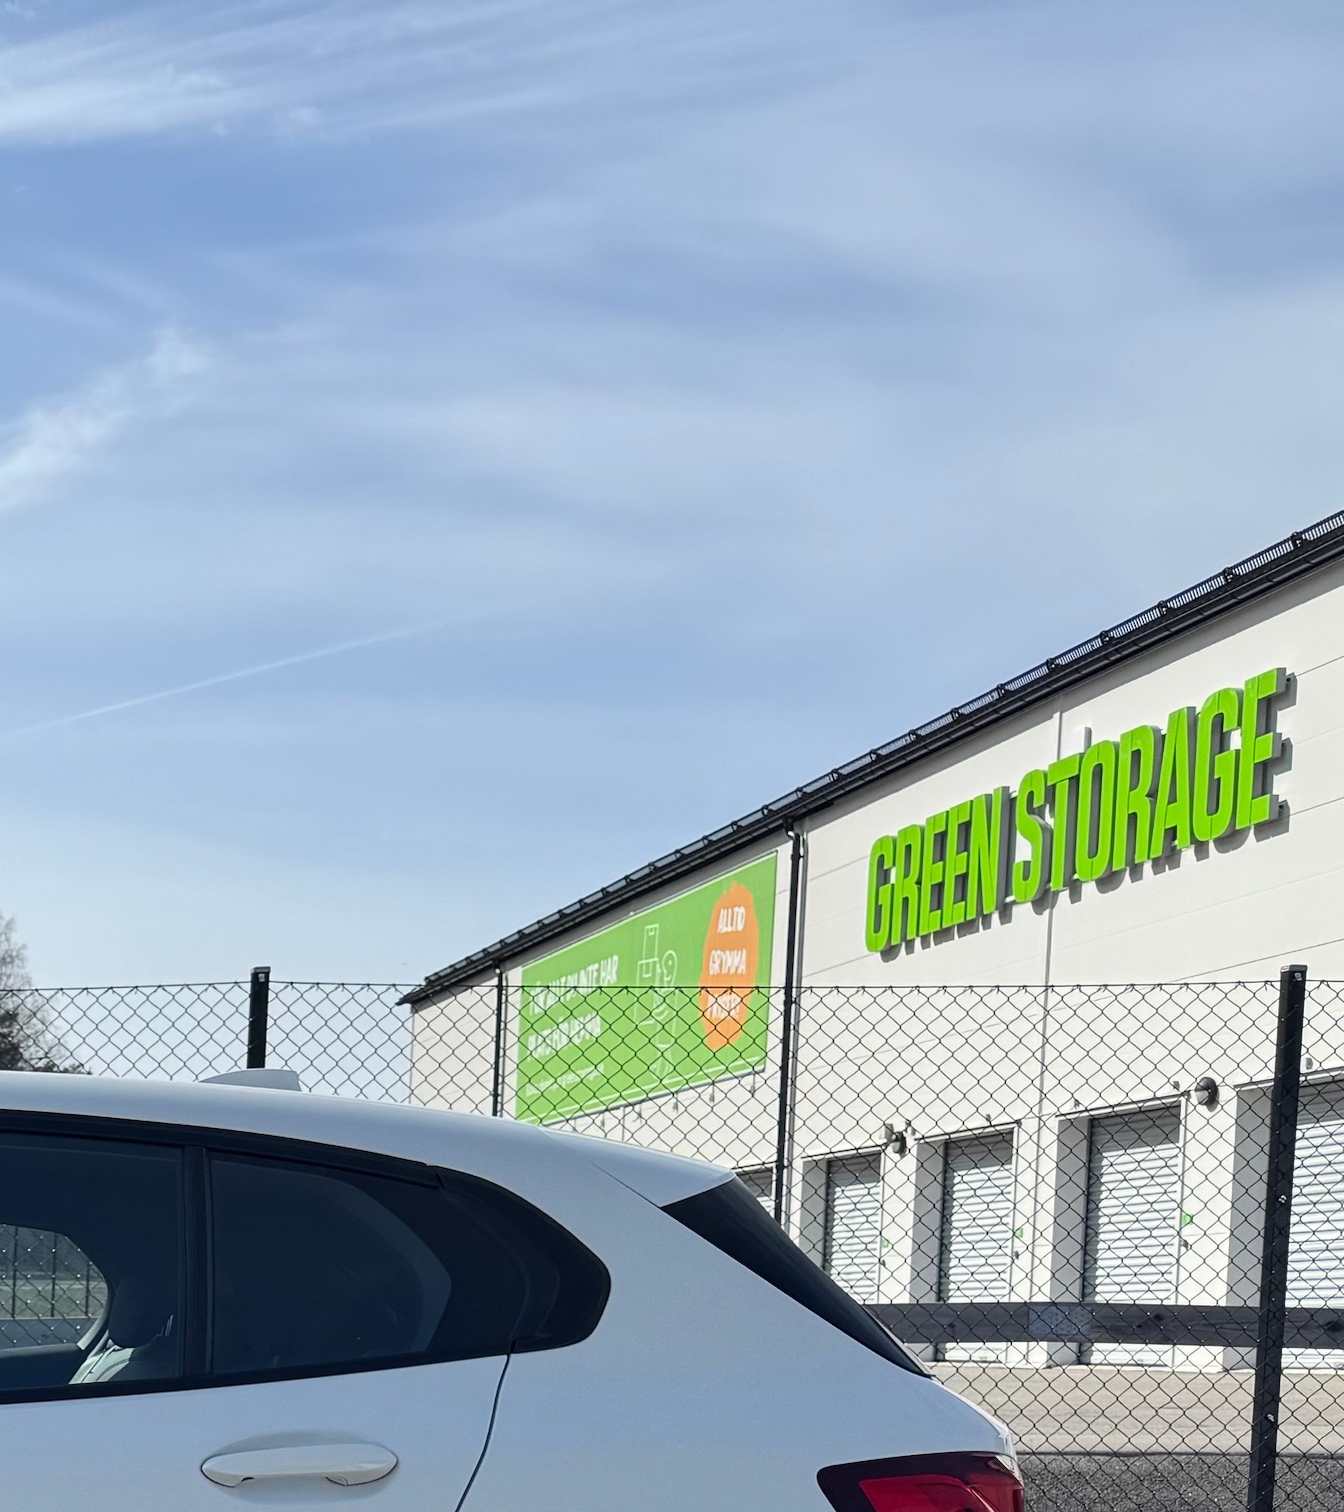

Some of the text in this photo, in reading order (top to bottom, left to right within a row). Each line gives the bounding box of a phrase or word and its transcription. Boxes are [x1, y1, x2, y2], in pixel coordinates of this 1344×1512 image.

[865, 667, 1287, 952] GREEN STORAGE
[600, 954, 619, 986] HAR
